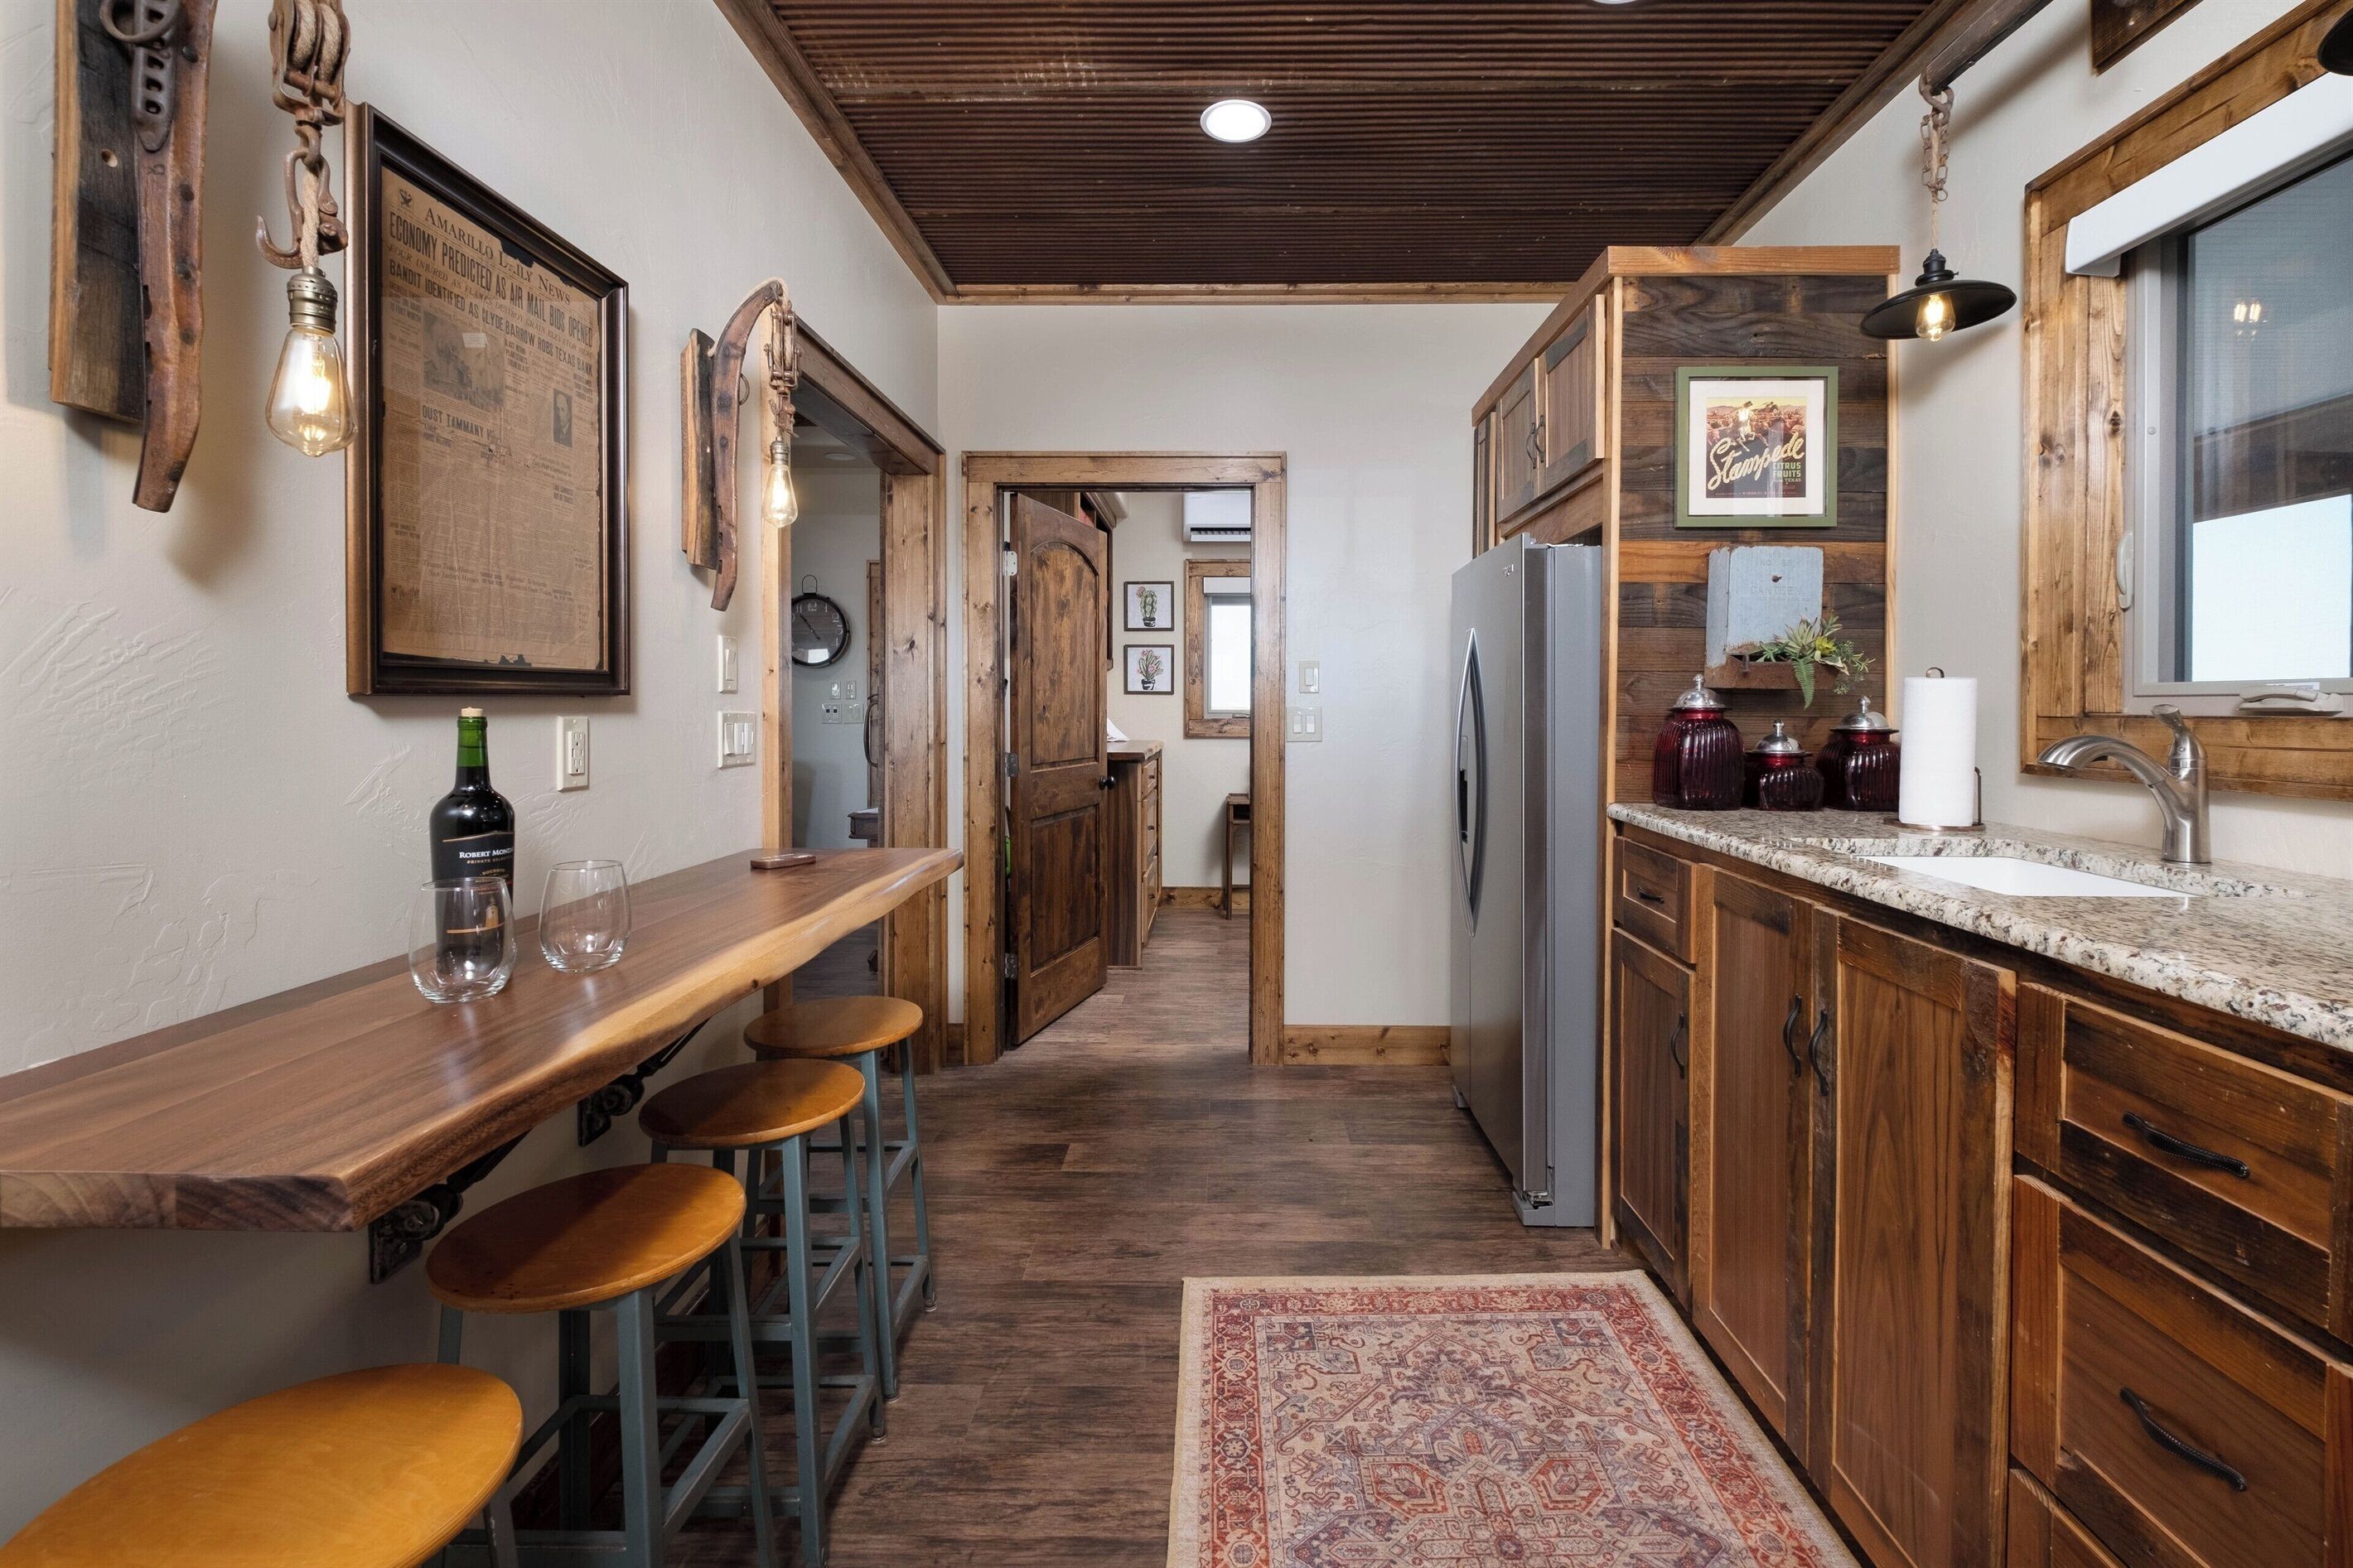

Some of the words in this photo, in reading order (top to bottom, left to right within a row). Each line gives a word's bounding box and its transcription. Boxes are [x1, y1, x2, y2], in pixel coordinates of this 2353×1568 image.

[424, 208, 493, 259] AMARILLO
[539, 275, 569, 305] NEWS
[389, 211, 437, 261] ECONOMY
[442, 243, 491, 292] PREDICTED
[495, 273, 506, 299] AS
[510, 282, 523, 309] AIR
[526, 292, 546, 321] MAIL
[548, 305, 565, 332] BIDS
[568, 316, 592, 347] OPENED
[389, 245, 412, 262] FOUR
[416, 259, 447, 282] INJURED
[451, 277, 461, 289] AS
[464, 286, 492, 304] FLAMES
[495, 302, 523, 321] DESTROY
[525, 318, 545, 334] GRAIN
[548, 330, 577, 350] ELEVATOR
[389, 259, 422, 288] BANDIT
[424, 277, 465, 311] IDENTIFIED
[467, 301, 478, 318] AS
[481, 308, 504, 330] CLYDE
[505, 321, 535, 346] BARROW
[537, 337, 553, 355] ROBS
[555, 346, 576, 367] TEXAS
[576, 358, 592, 375] BANK
[422, 405, 442, 422] OUST
[446, 414, 484, 437] TAMMANY
[1707, 432, 1805, 490] Stampede
[1772, 461, 1801, 470] CITRUS
[1772, 470, 1801, 478] FRUITS
[808, 601, 817, 611] 12
[832, 613, 839, 623] 2
[835, 625, 843, 635] 3
